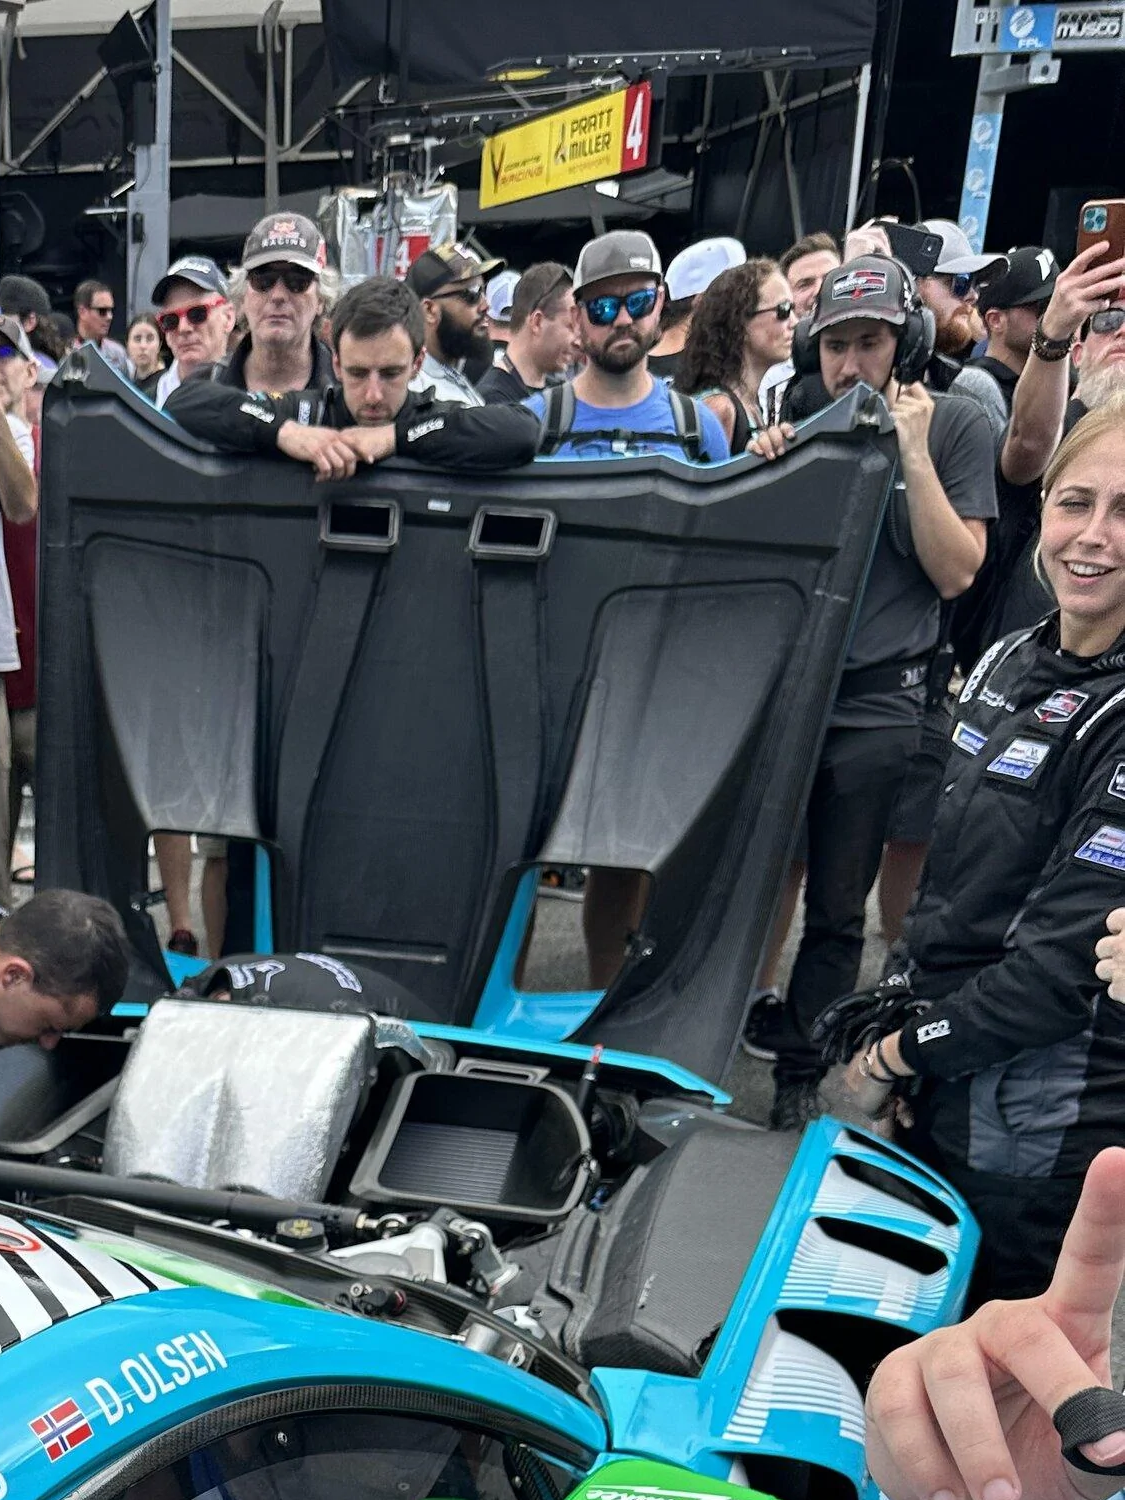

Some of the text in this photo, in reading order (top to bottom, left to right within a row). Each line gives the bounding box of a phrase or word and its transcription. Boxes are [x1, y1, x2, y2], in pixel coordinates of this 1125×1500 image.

[570, 108, 613, 138] PRATT
[626, 91, 644, 160] 4
[569, 133, 611, 162] MILLER
